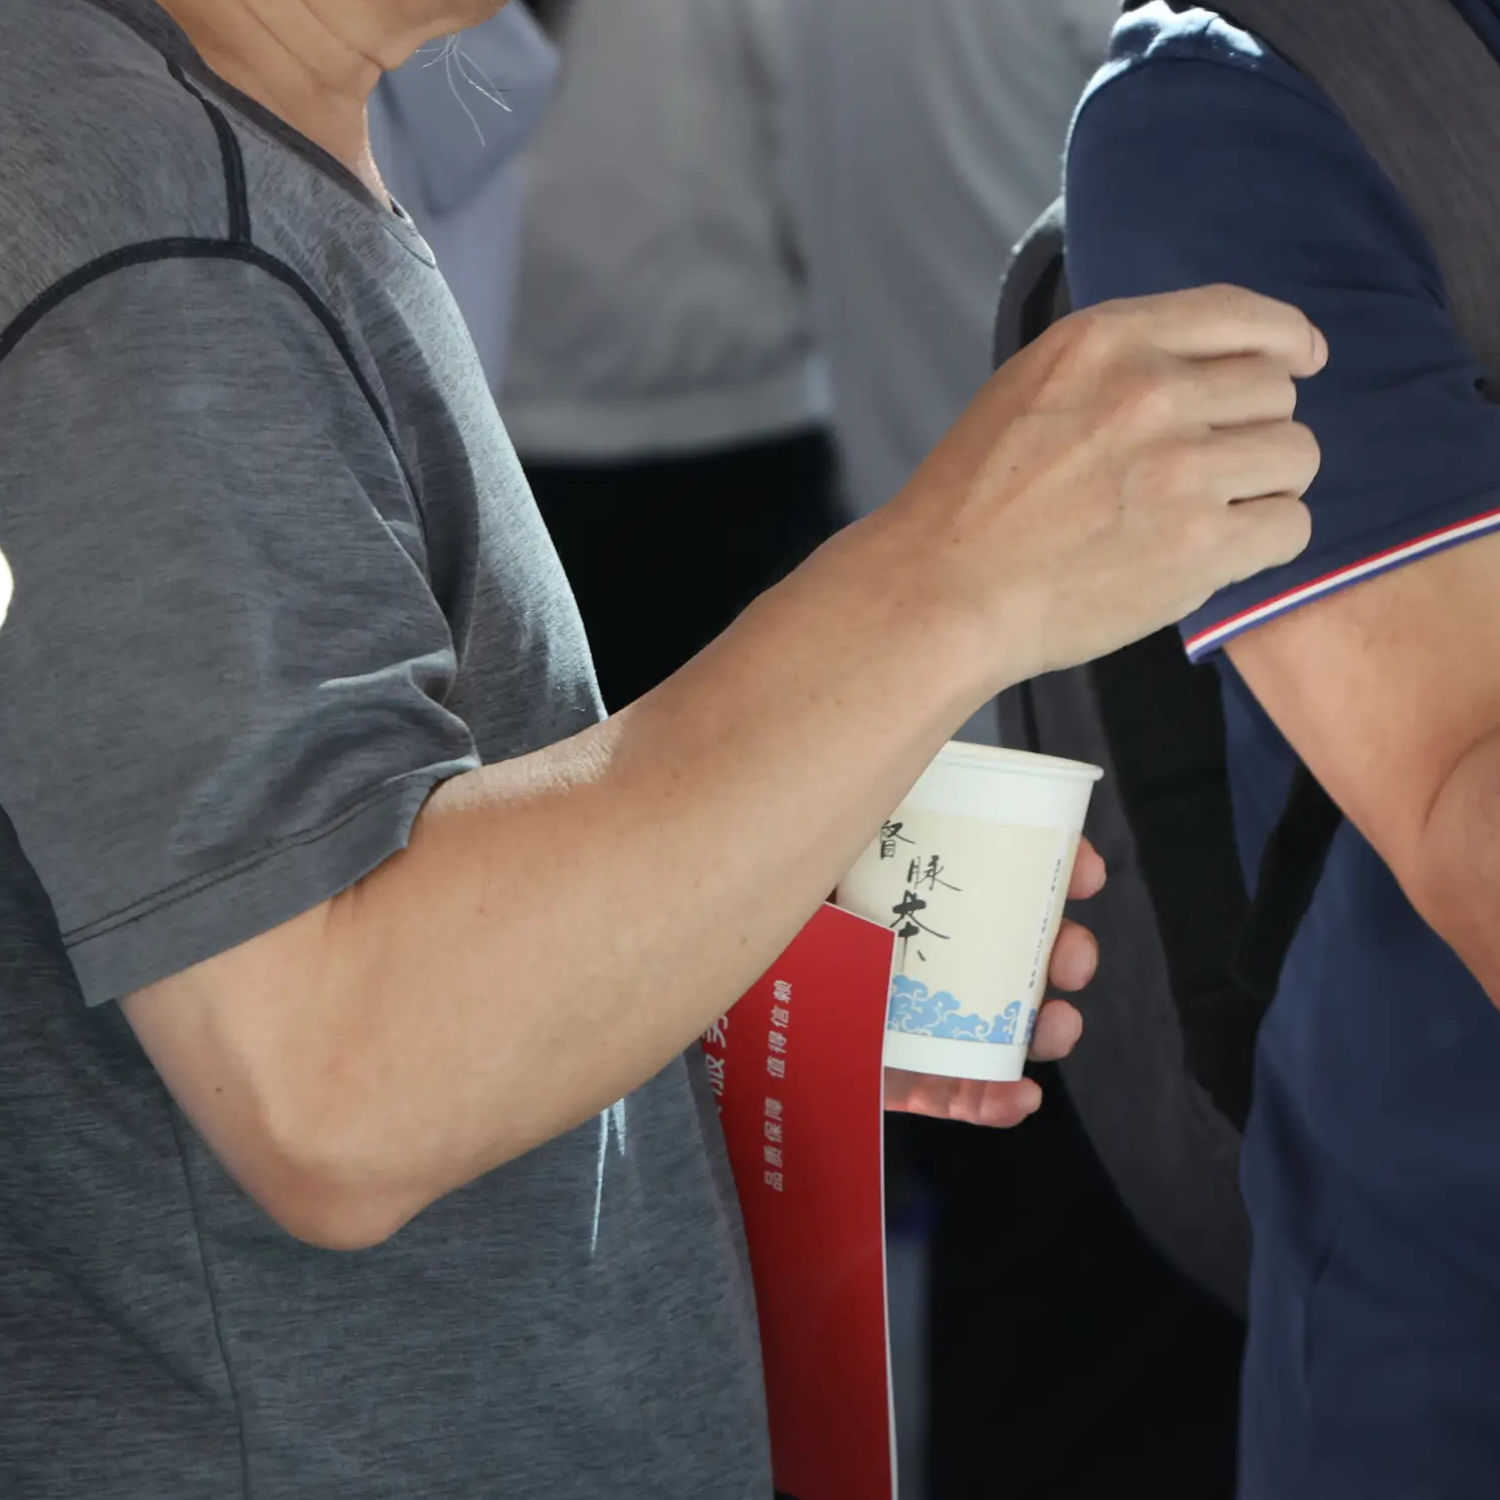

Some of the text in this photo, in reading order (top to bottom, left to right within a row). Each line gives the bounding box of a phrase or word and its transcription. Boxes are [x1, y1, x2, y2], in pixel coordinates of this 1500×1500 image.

[763, 980, 792, 1192] 品质保障 值得信赖
